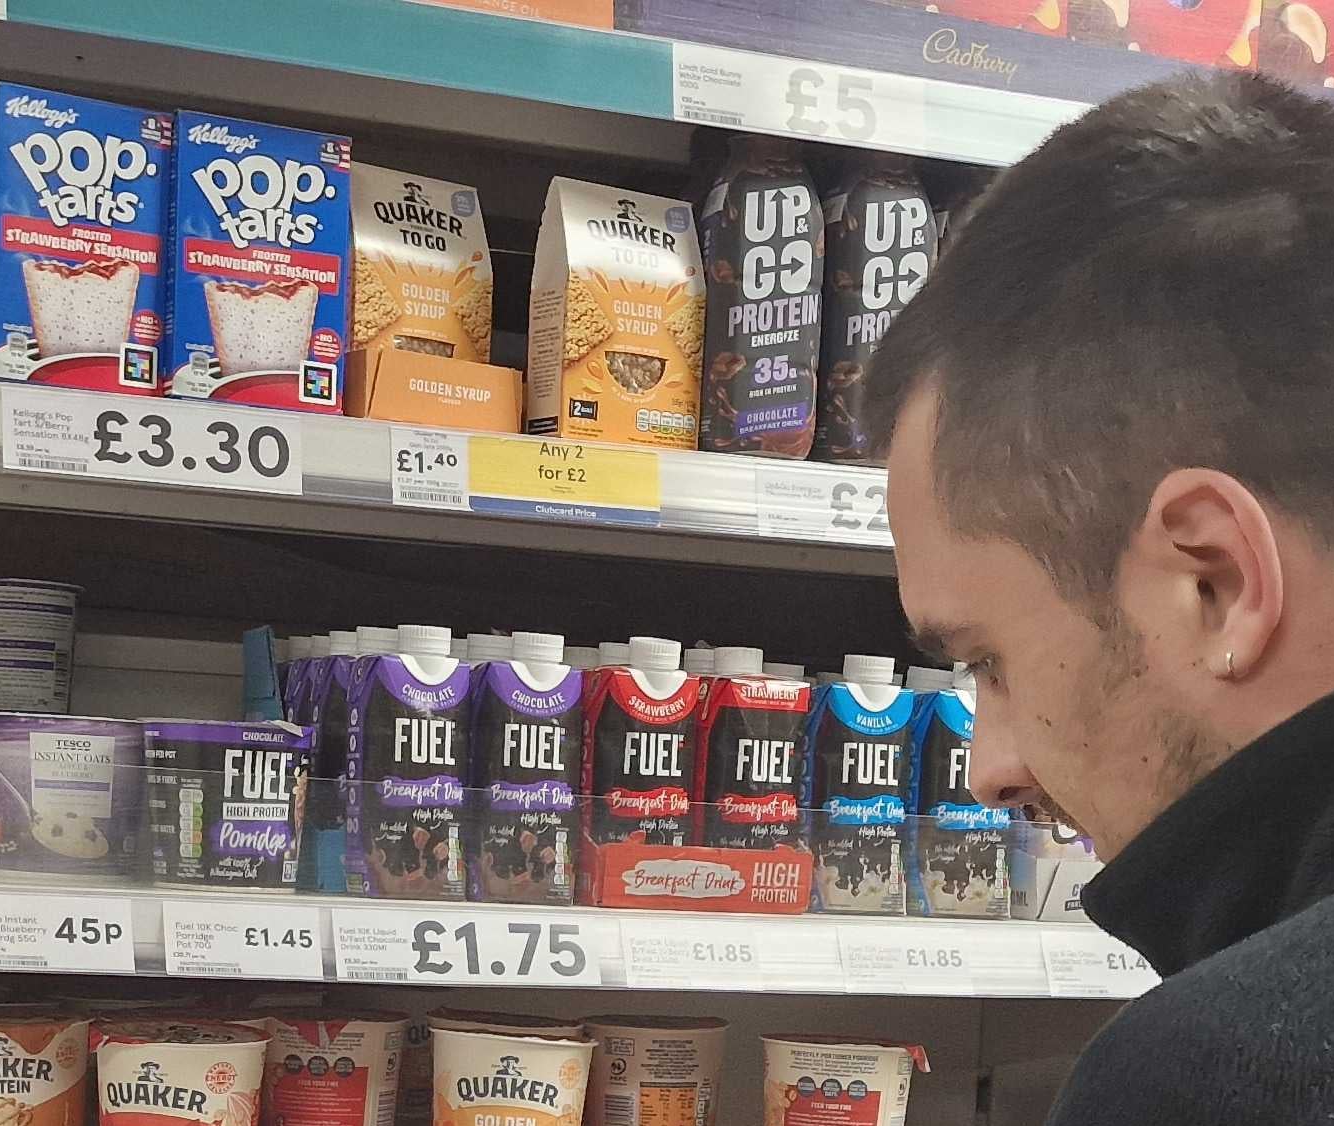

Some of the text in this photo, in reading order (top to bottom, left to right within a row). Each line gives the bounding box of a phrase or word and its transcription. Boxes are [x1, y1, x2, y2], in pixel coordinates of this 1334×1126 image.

[923, 28, 1017, 84] Cadbury
[786, 67, 878, 140] £5
[373, 198, 465, 237] QUAKER
[399, 229, 447, 251] TO GO
[401, 281, 450, 303] GOLDEN
[404, 298, 445, 318] SYRUP
[728, 293, 819, 336] PROTEIN
[13, 409, 52, 421] Kellogg's
[94, 410, 290, 478] £3.30
[401, 683, 454, 704] CHOCOLATE
[628, 696, 686, 718] STRAWBERRY
[856, 714, 891, 726] VANILLA
[394, 718, 455, 767] FUEL
[843, 741, 899, 786] FUEL
[218, 822, 286, 854] Porridge
[633, 867, 745, 892] Breakfast Drink
[752, 862, 800, 885] HIGH
[751, 886, 798, 903] PROTEIN
[4, 915, 37, 924] Instant
[55, 917, 122, 944] 45p
[244, 928, 313, 948] £1.45
[412, 919, 585, 978] £1.75
[692, 941, 751, 965] £1.85
